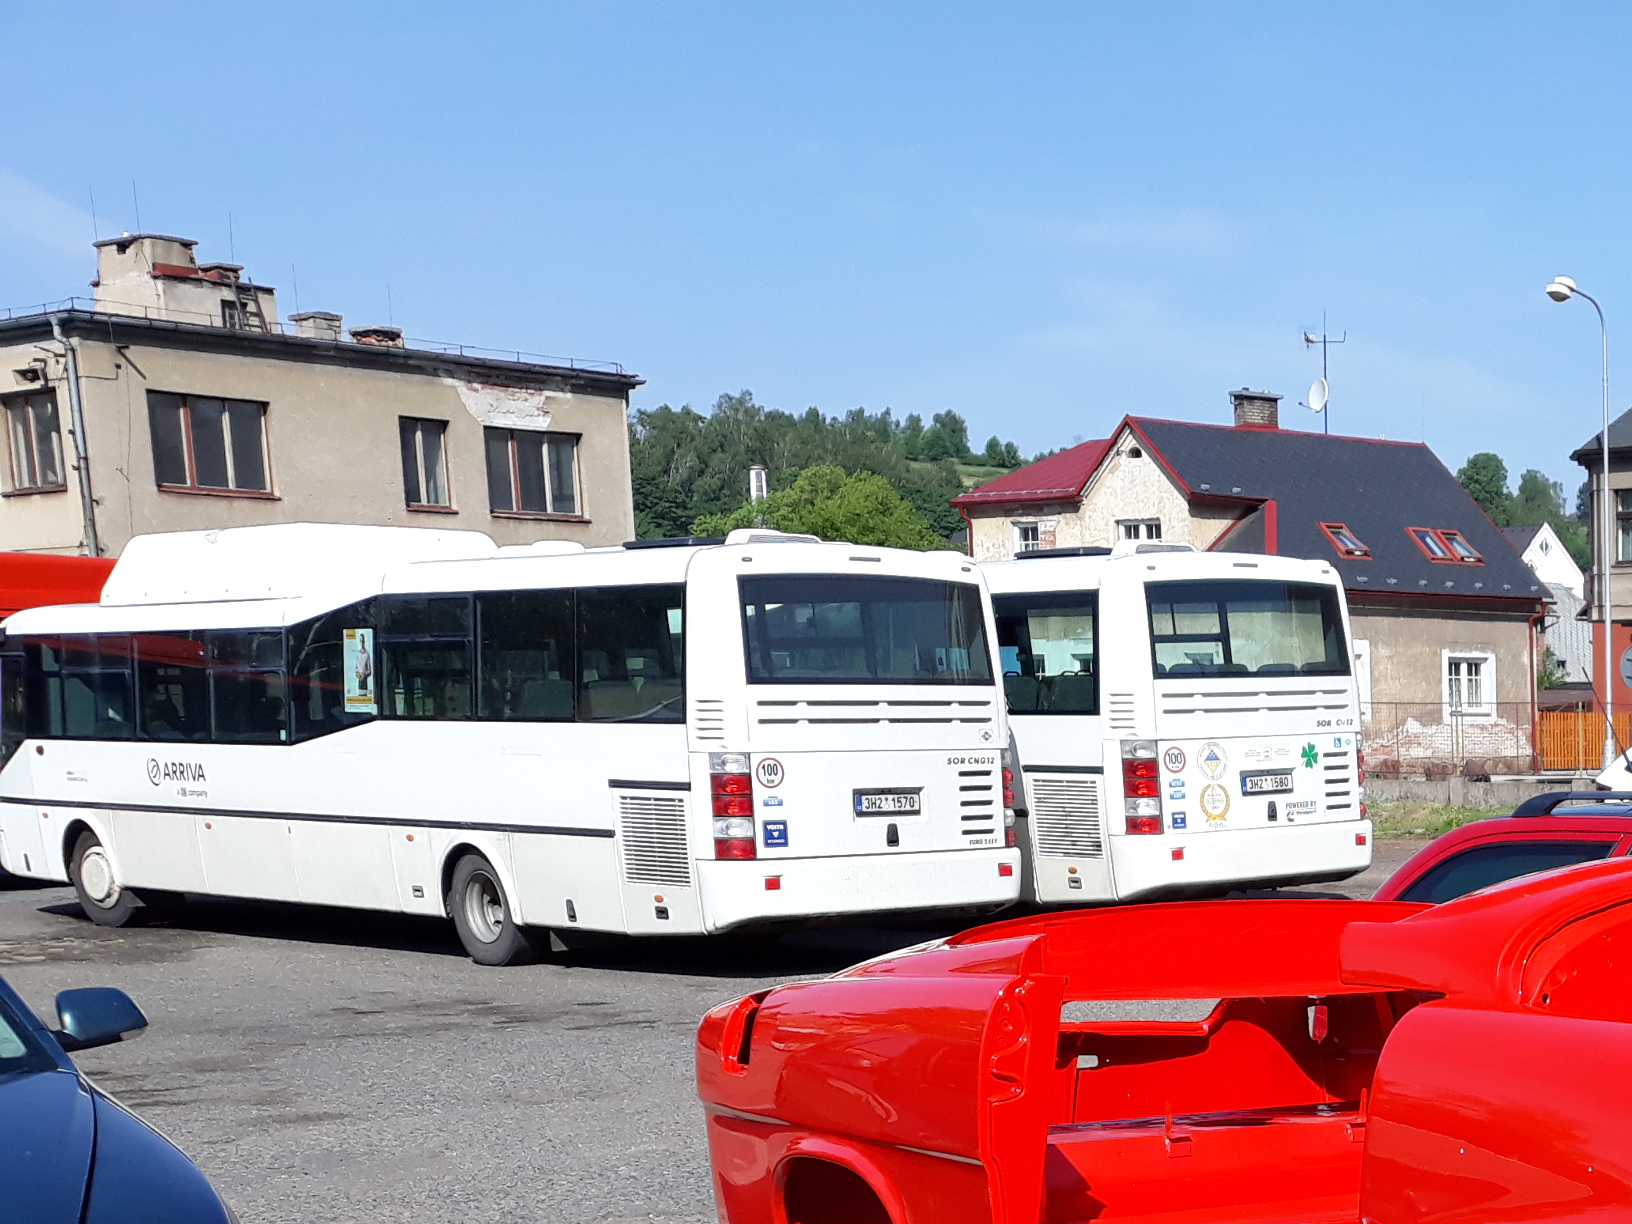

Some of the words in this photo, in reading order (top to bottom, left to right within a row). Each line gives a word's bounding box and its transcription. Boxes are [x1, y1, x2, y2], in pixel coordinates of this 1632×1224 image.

[947, 757, 966, 765] SOR
[968, 757, 995, 765] CNG12
[1167, 752, 1182, 765] 100
[163, 762, 206, 782] ARRIVA
[762, 763, 778, 777] 100
[1249, 778, 1264, 790] 3H2
[864, 797, 883, 810] 3H2
[891, 796, 915, 809] 1570
